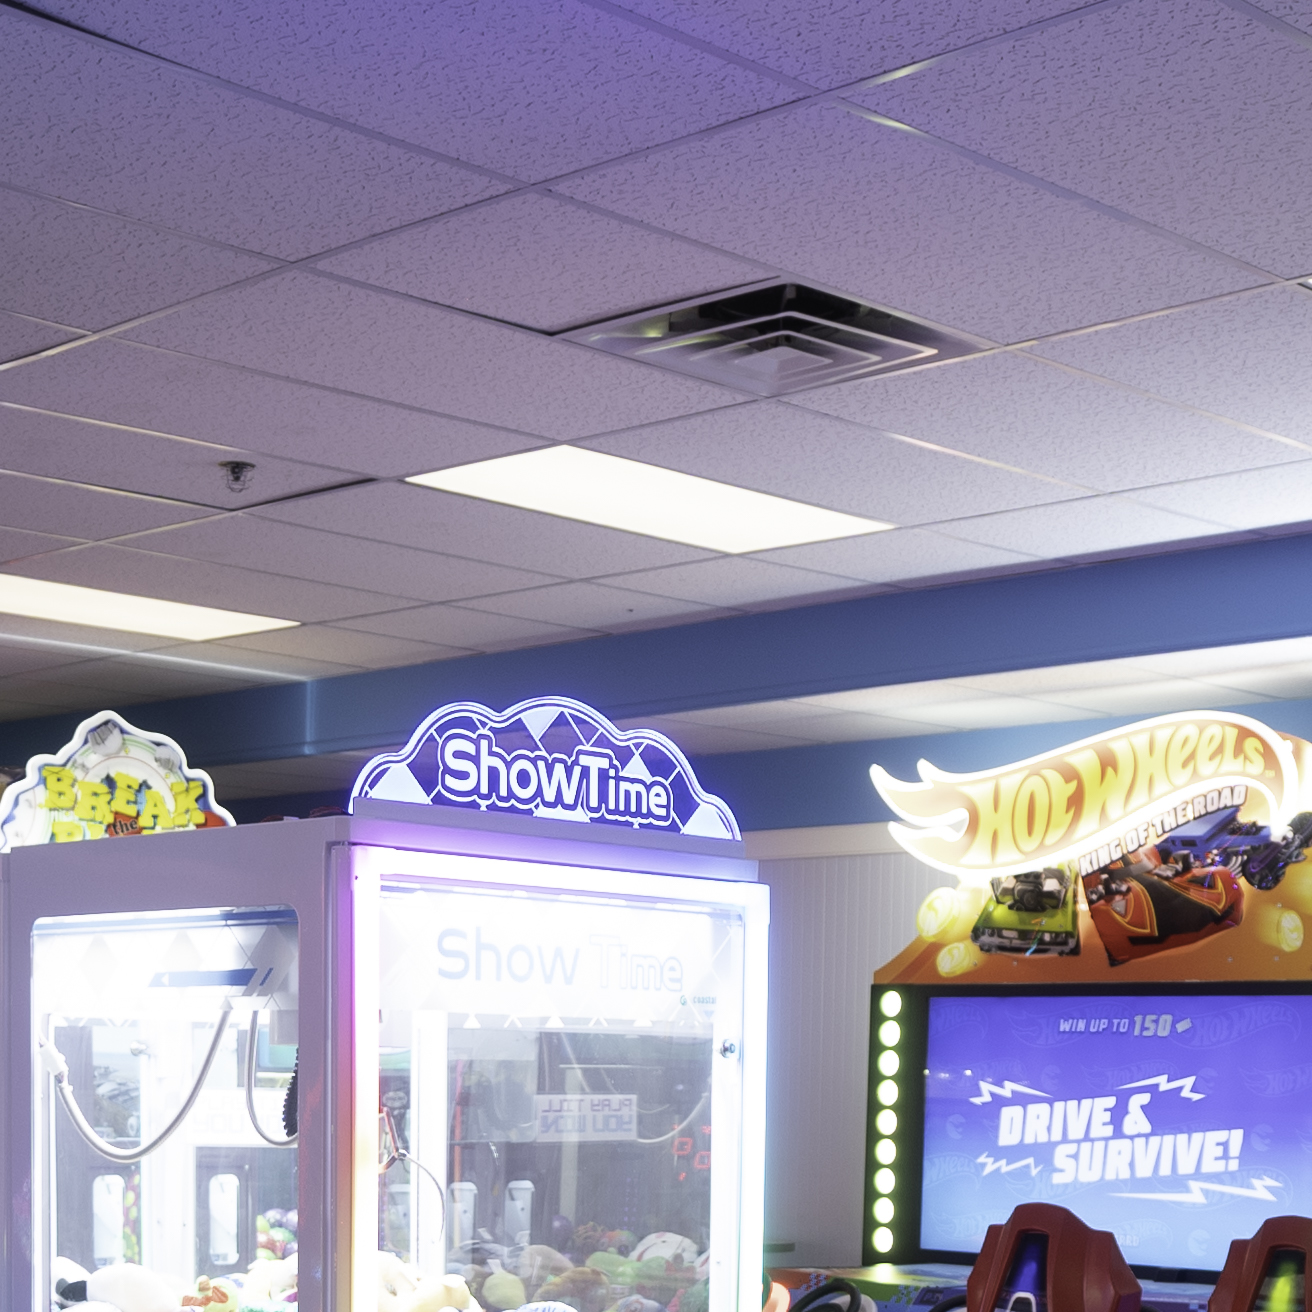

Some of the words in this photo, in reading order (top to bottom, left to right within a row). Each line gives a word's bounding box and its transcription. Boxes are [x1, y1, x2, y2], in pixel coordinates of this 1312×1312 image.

[41, 765, 206, 830] BREAK
[444, 738, 668, 817] ShowTime
[957, 768, 1078, 867] HOT
[1065, 722, 1267, 841] WHEELS
[112, 817, 138, 836] the
[1078, 836, 1123, 877] KING
[1125, 825, 1150, 853] OF
[1151, 804, 1189, 839] THE
[1193, 785, 1248, 818] ROAD
[437, 926, 580, 986] Show
[589, 934, 684, 993] Time
[1058, 1018, 1086, 1034] WIN
[1088, 1018, 1109, 1033] UP
[1112, 1018, 1129, 1033] TO
[1133, 1014, 1174, 1038] 150
[998, 1095, 1117, 1147] DRIVE
[1121, 1092, 1152, 1136] &
[1051, 1127, 1245, 1186] SURVIVE!
